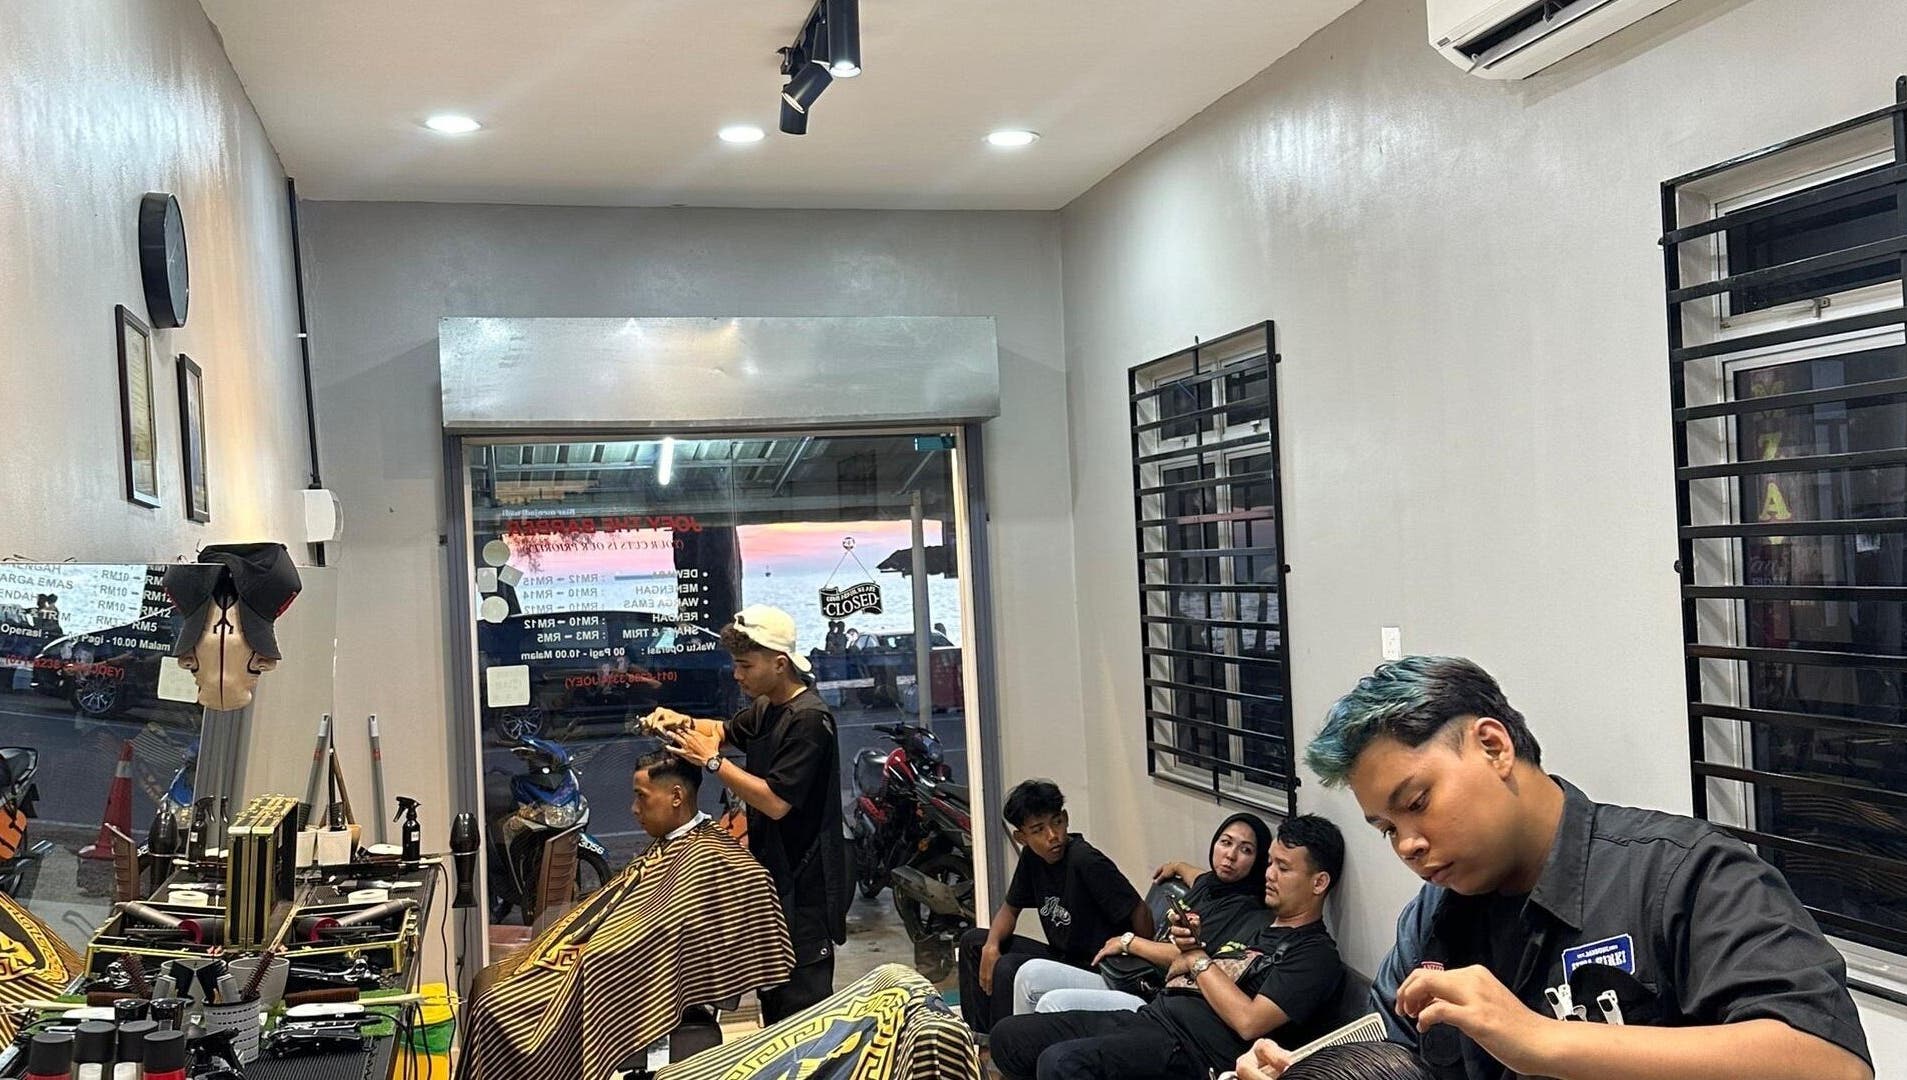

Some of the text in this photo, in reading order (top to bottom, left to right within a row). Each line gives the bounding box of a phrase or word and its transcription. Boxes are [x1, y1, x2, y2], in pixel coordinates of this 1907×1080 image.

[37, 577, 74, 590] EMAS
[100, 584, 128, 597] RM10
[97, 600, 126, 612] RM10
[825, 592, 878, 617] CLOSED
[131, 621, 158, 632] RM5
[0, 623, 42, 637] Operasi
[82, 634, 104, 646] Pagi
[112, 637, 137, 648] 10.00
[139, 640, 171, 652] Malam
